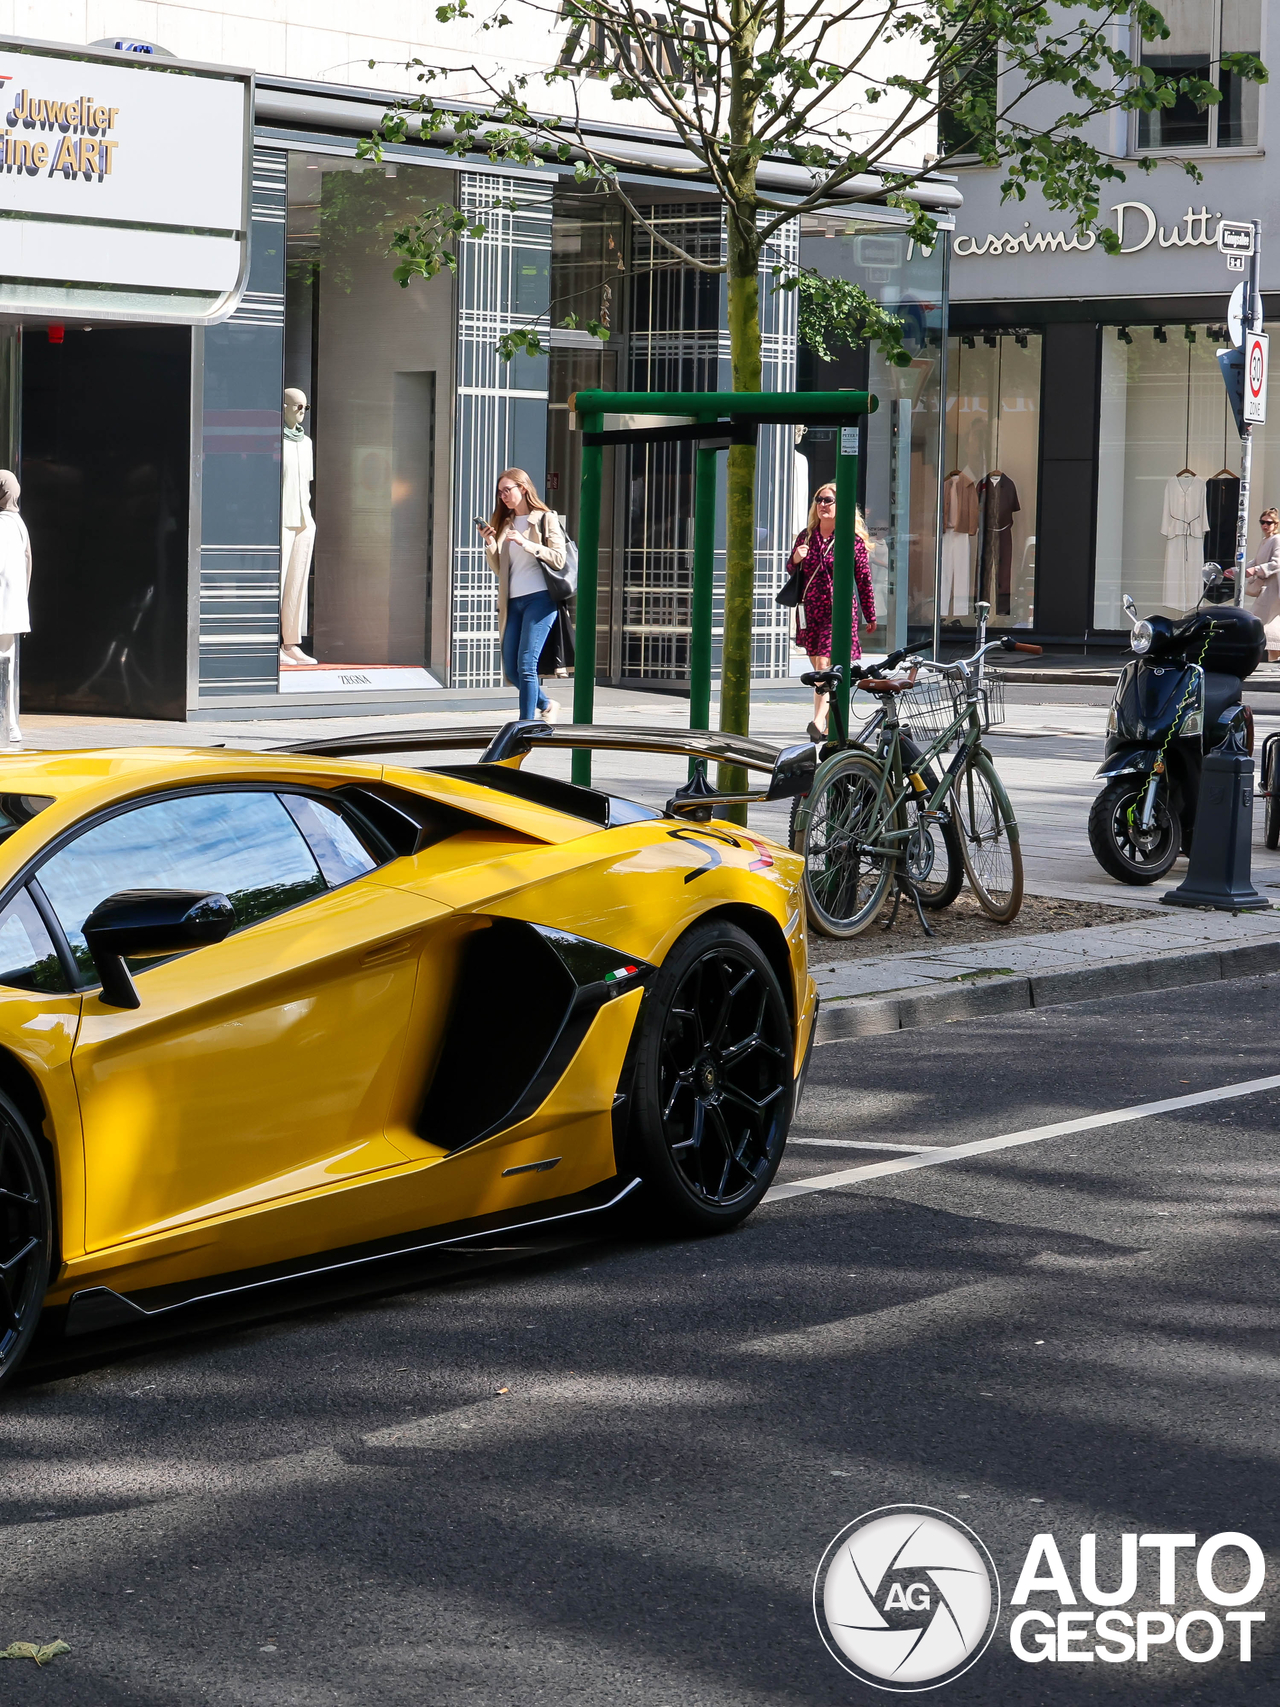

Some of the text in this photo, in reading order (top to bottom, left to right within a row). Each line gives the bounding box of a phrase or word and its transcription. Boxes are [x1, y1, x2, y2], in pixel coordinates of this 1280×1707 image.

[12, 88, 120, 129] Juwelier
[54, 135, 119, 175] ART
[1251, 355, 1261, 382] 30
[1249, 401, 1261, 416] ZONE
[337, 674, 372, 685] ZEGNA
